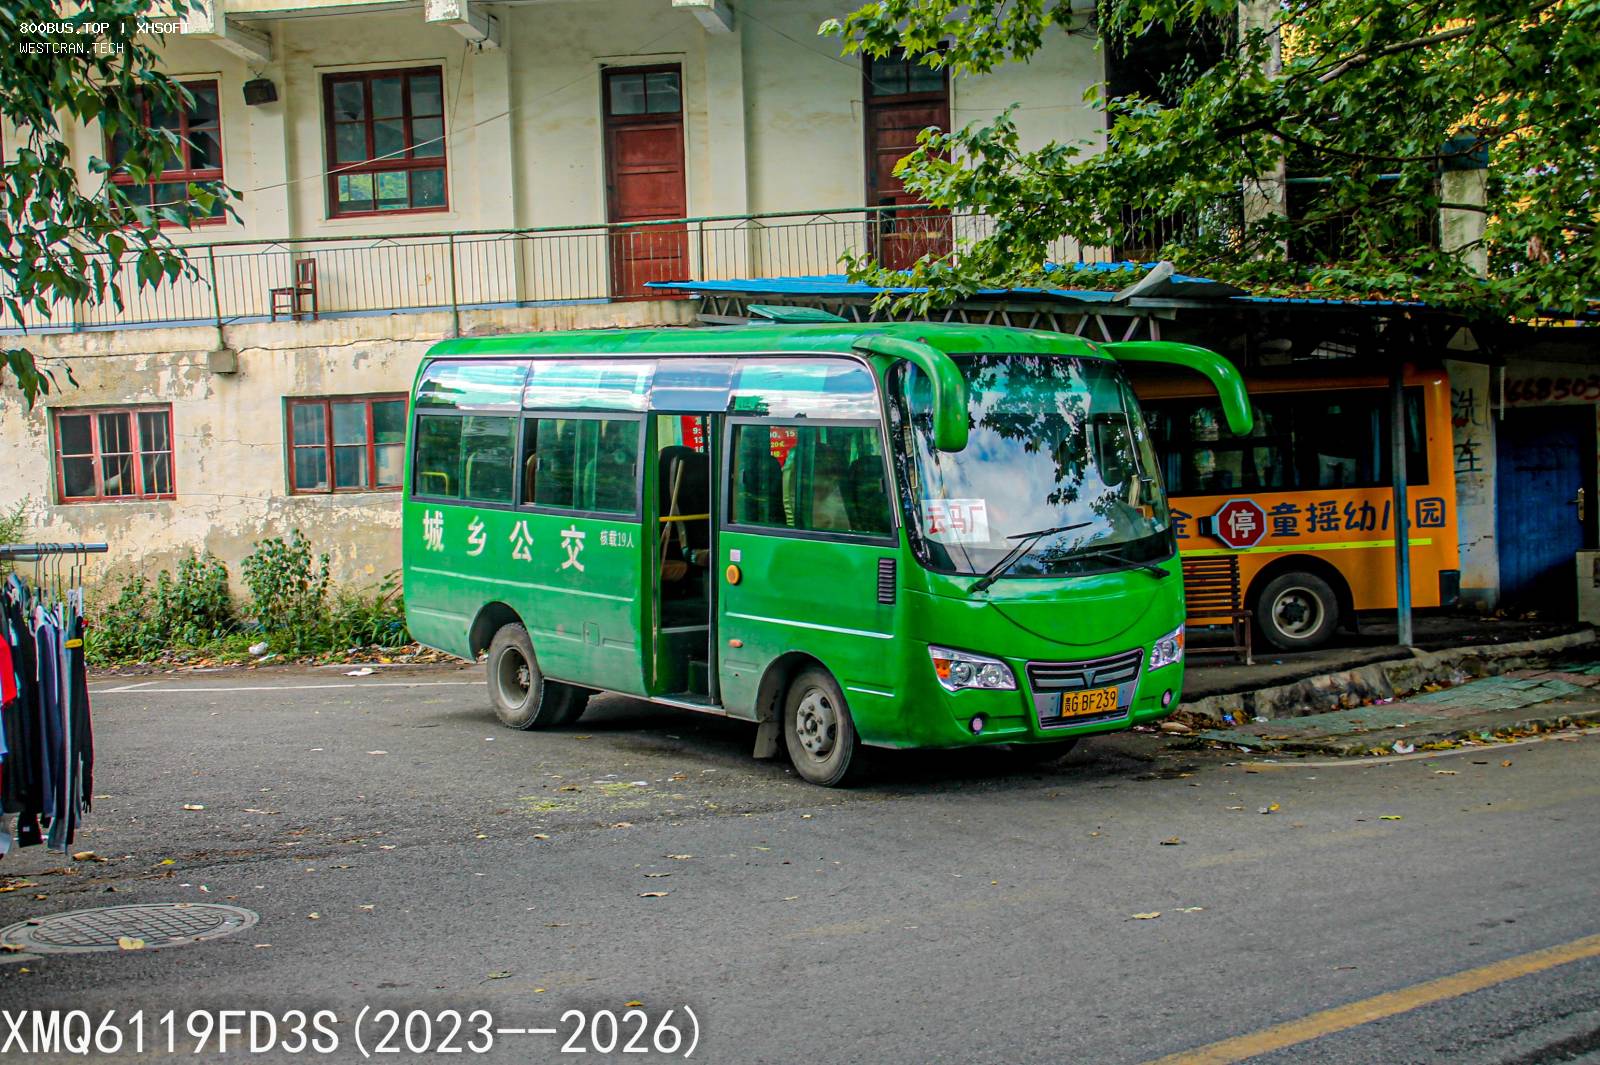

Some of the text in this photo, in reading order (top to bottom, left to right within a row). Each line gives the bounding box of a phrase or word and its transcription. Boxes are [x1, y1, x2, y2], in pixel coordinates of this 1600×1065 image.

[926, 504, 983, 534] 云马厂
[1227, 510, 1256, 538] 停
[422, 509, 586, 572] 城乡公交
[599, 529, 635, 548] 核载19人
